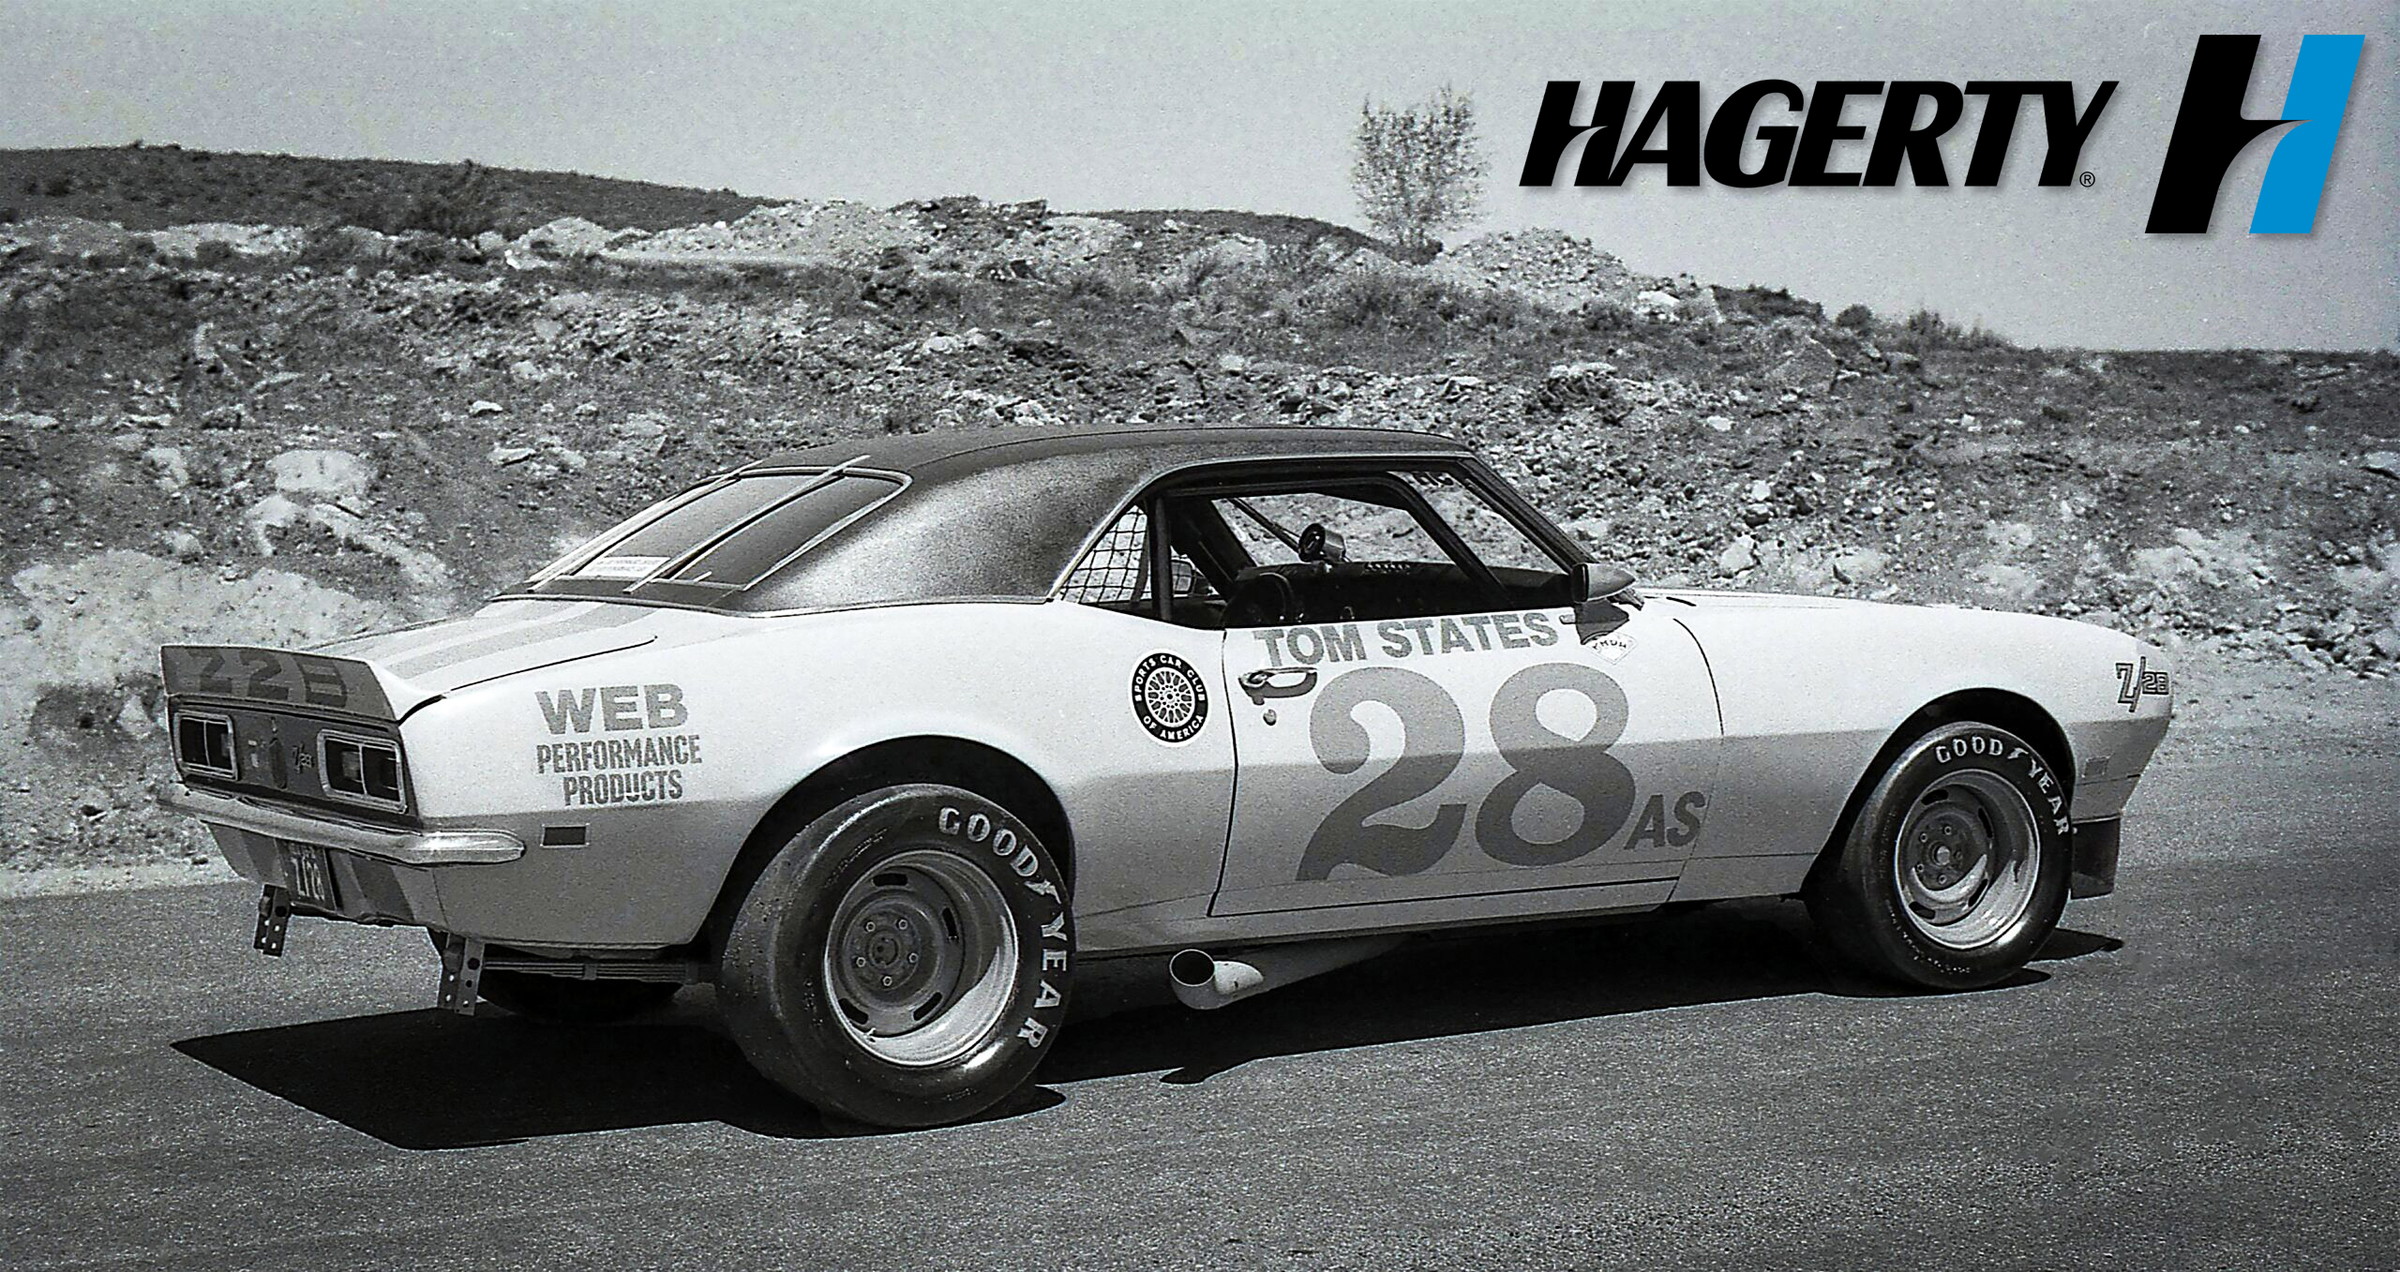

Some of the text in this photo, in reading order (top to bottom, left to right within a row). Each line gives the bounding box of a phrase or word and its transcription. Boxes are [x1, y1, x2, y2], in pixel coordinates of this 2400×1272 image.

[1252, 612, 1559, 668] TOM STATES
[1134, 655, 1206, 702] SPORTS CAR CLUB
[535, 683, 688, 735] WEB
[1143, 714, 1204, 740] OF AMERICA
[536, 734, 703, 774] PERFORMANCE
[1295, 662, 1636, 881] 28
[563, 769, 684, 806] PRODUCTS
[1622, 791, 1706, 850] AS
